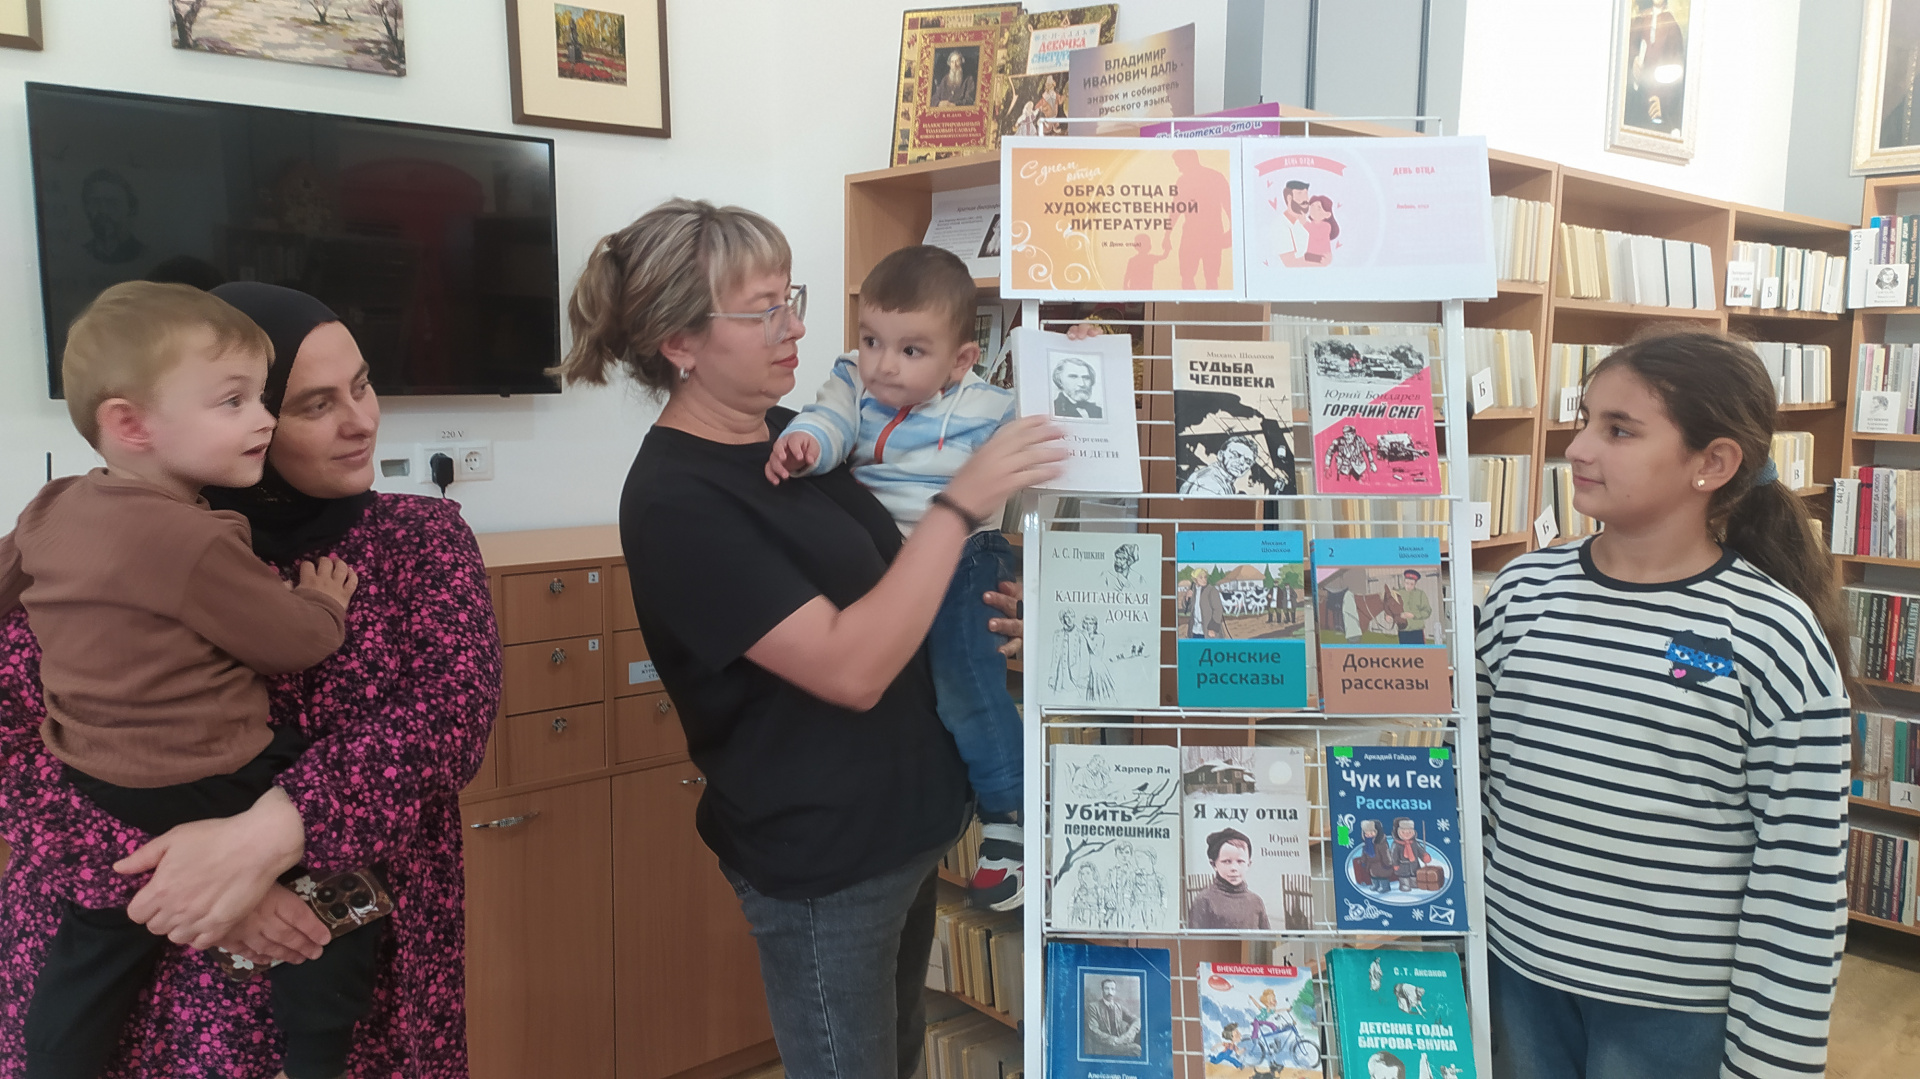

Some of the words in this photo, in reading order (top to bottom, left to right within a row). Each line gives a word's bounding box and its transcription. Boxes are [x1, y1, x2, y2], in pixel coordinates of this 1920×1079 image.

[1104, 48, 1167, 71] ВЛАДИМИР
[1083, 67, 1148, 90] ИВАНОВИЧ
[1150, 61, 1178, 77] ДАЛЬ
[1087, 93, 1120, 105] знаток
[1122, 91, 1128, 99] и
[1131, 80, 1180, 97] собиратель
[1099, 101, 1141, 115] русского
[1143, 95, 1170, 107] языка
[1230, 121, 1251, 132] это
[1393, 167, 1413, 176] ДЕНЬ
[1415, 166, 1435, 175] ОТЦА
[1063, 184, 1115, 197] ОБРАЗ
[1120, 184, 1164, 199] ОТЦА
[1169, 184, 1179, 197] В
[1044, 199, 1199, 216] ХУДОЖЕСТВЕННОЙ
[1070, 218, 1173, 231] ЛИТЕРАТУРЕ
[1767, 287, 1773, 298] Б
[1206, 350, 1237, 359] Михаил
[1239, 352, 1275, 360] Шолохов
[1189, 360, 1254, 375] СУДЬБА
[1189, 373, 1275, 389] ЧЕЛОВЕКА
[1324, 388, 1361, 400] Юрий
[1365, 390, 1421, 402] Бондарев
[1479, 382, 1486, 397] Б
[1323, 402, 1386, 419] ГОРЯЧИЙ
[1388, 405, 1425, 420] СНЕГ
[441, 430, 456, 438] 220
[457, 430, 464, 438] V
[1074, 435, 1109, 444] Тургенев
[1090, 450, 1120, 459] ДЕТИ
[1794, 468, 1800, 480] В
[1836, 480, 1845, 504] 84(2)6
[1874, 493, 1880, 502] ДА
[1474, 513, 1483, 528] В
[1542, 521, 1550, 535] Б
[1191, 541, 1196, 551] 1
[1328, 548, 1334, 558] 2
[1051, 547, 1060, 559] А.
[1062, 547, 1070, 559] С.
[1072, 547, 1105, 562] Пушкин
[1055, 590, 1150, 605] КАПИТАНСКАЯ
[1105, 609, 1150, 624] ДОЧКА
[1199, 648, 1281, 667] Донские
[1343, 653, 1424, 672] Донские
[1197, 672, 1285, 688] рассказы
[1342, 677, 1429, 694] рассказы
[1363, 753, 1393, 761] Аркадий
[1393, 753, 1417, 762] Гайдар
[1114, 764, 1153, 775] Харпер
[1156, 765, 1171, 775] Ли
[1341, 770, 1381, 792] Чук
[1386, 773, 1400, 788] и
[1406, 770, 1442, 789] Гек
[1356, 795, 1432, 811] Рассказы
[1900, 790, 1912, 803] Д
[1064, 803, 1133, 823] Убить
[1193, 804, 1207, 819] Я
[1214, 807, 1249, 823] жду
[1255, 807, 1299, 821] отца
[1064, 822, 1170, 840] пересмешника
[1269, 833, 1299, 846] Юрий
[1216, 965, 1264, 975] ВНЕКЛАССНОЕ
[1267, 967, 1292, 976] ЧТЕНИЕ
[1414, 968, 1448, 978] Аксаков
[1359, 1021, 1414, 1036] ДЕТСКИЕ
[1415, 1024, 1454, 1038] ГОДЫ
[1358, 1036, 1458, 1052] БАГРОВА-ВНУКА
